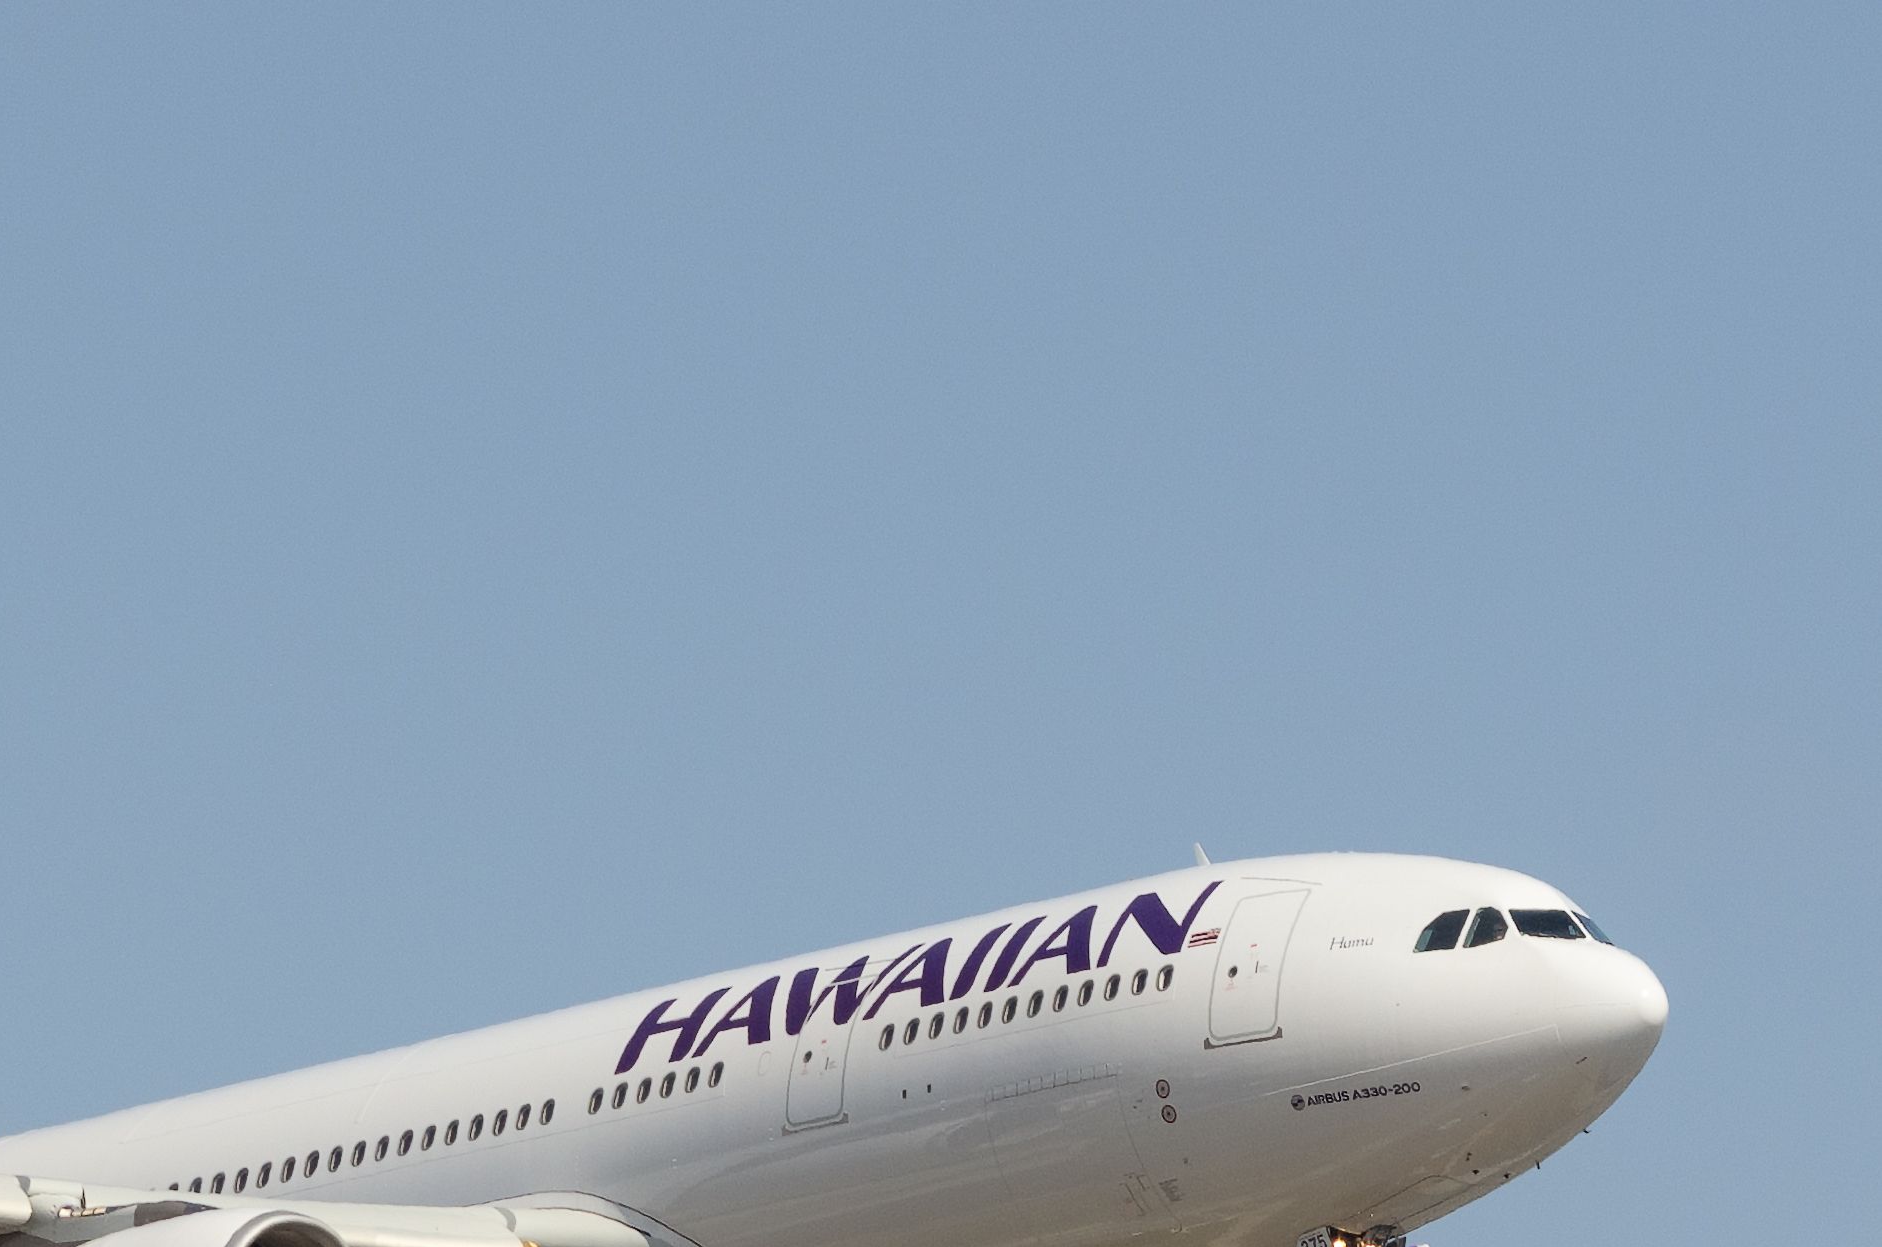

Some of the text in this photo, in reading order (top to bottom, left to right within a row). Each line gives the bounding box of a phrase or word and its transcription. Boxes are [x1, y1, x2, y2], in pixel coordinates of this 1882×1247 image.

[614, 881, 1224, 1074] HAWAIIAN
[1307, 1081, 1421, 1106] AIRBUS A330-200
